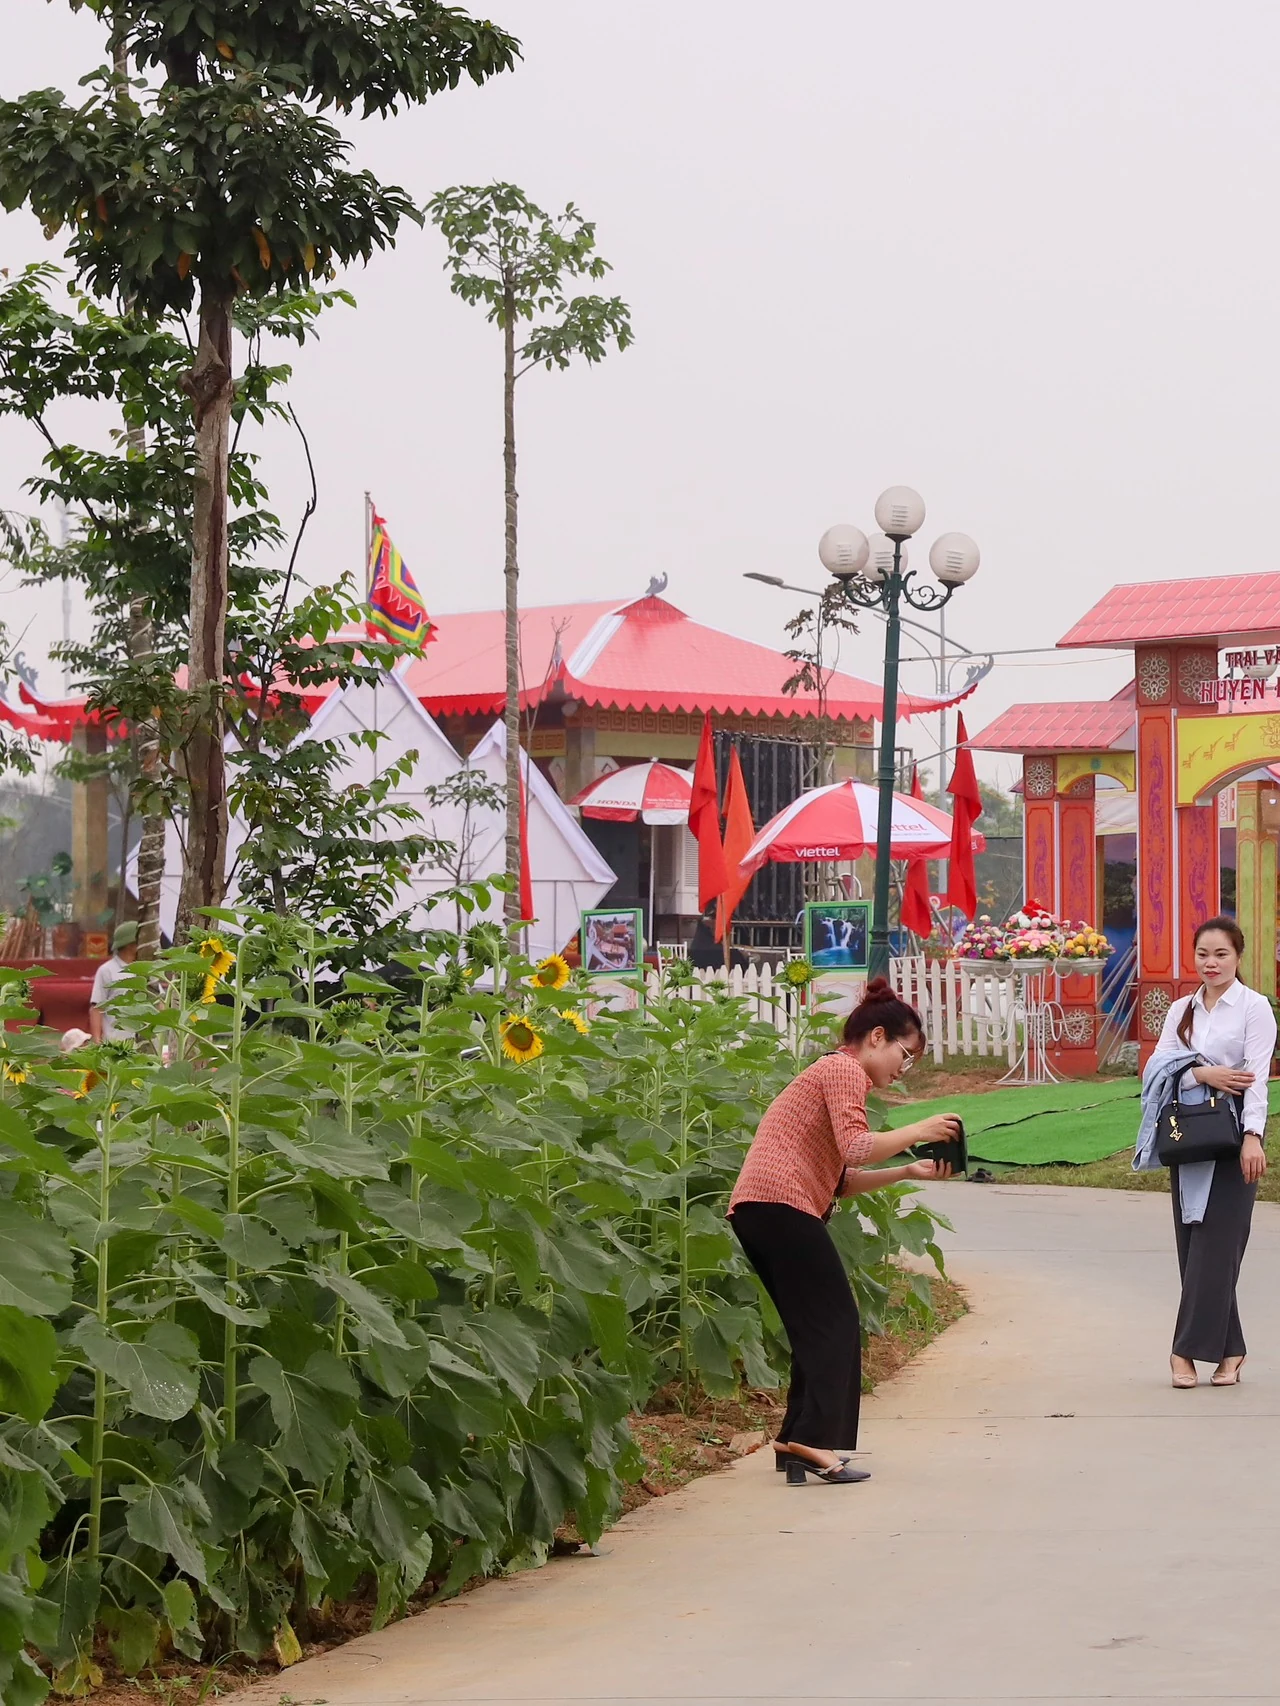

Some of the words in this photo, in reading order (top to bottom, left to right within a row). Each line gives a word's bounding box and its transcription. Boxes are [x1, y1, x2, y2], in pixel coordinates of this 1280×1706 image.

[1226, 650, 1258, 669] TRẠI
[1200, 675, 1265, 704] HUYỆN
[597, 800, 636, 808] HONDA
[795, 847, 840, 857] viettel
